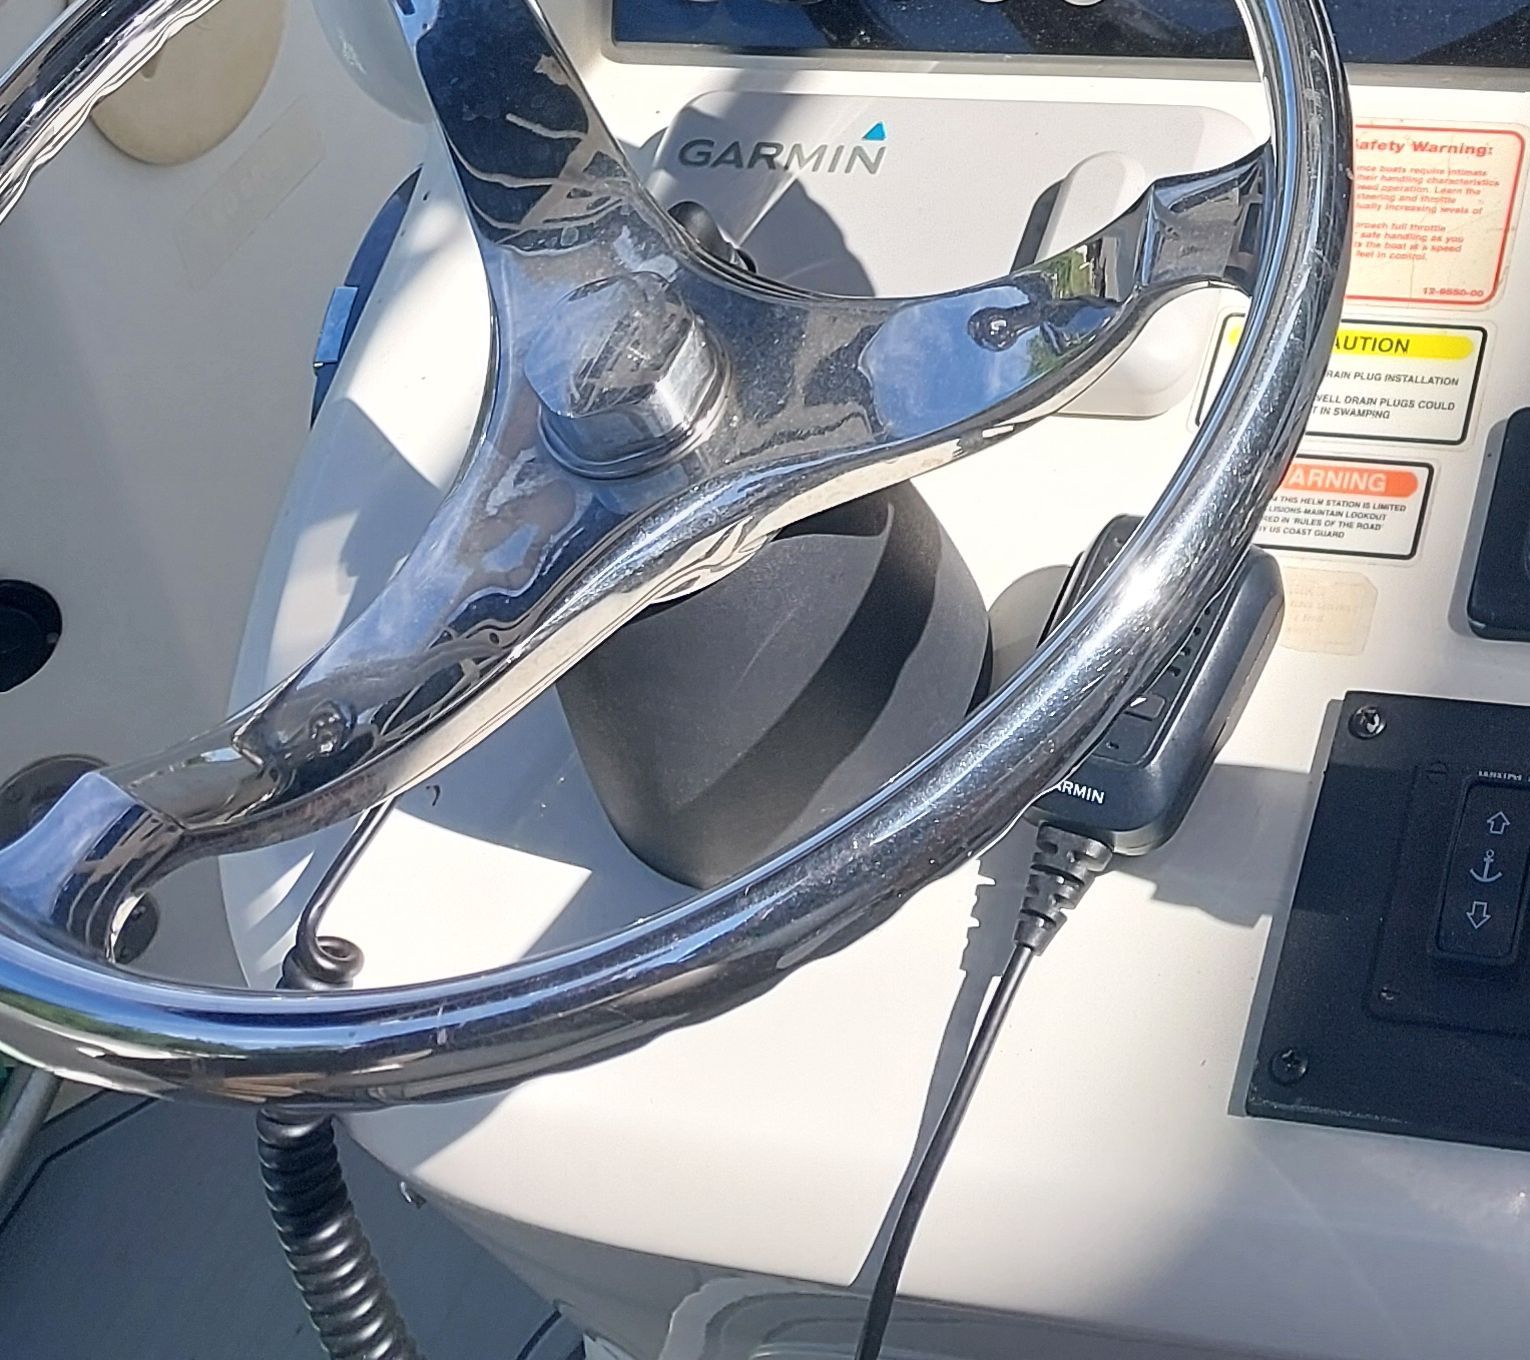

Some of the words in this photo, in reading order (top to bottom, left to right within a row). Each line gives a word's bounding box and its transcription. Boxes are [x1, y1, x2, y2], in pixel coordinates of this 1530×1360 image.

[677, 138, 886, 175] GARMIN
[1412, 141, 1493, 157] Warning:
[1335, 335, 1410, 353] AUTION
[1326, 370, 1350, 380] RAIN
[1353, 372, 1382, 382] PLUG
[1384, 374, 1459, 386] INSTALLATION
[1344, 395, 1377, 406] DRAIN
[1380, 397, 1415, 408] PLUGS
[1418, 400, 1455, 411] COULD
[1320, 406, 1331, 415] IN
[1333, 407, 1390, 419] SWAMPING
[1288, 468, 1387, 492] ARNING
[1280, 496, 1298, 504] THIS
[1300, 497, 1324, 505] HELM
[1326, 499, 1360, 508] STATION
[1362, 501, 1370, 509] IS
[1372, 503, 1406, 512] LIMITED
[1324, 519, 1336, 527] OF
[1338, 521, 1354, 529] THE
[1345, 511, 1387, 521] LOOKOUT
[1269, 526, 1281, 534] US
[1283, 527, 1312, 536] COAST
[1314, 529, 1345, 539] GUARD
[1055, 780, 1105, 804] ARMIN
